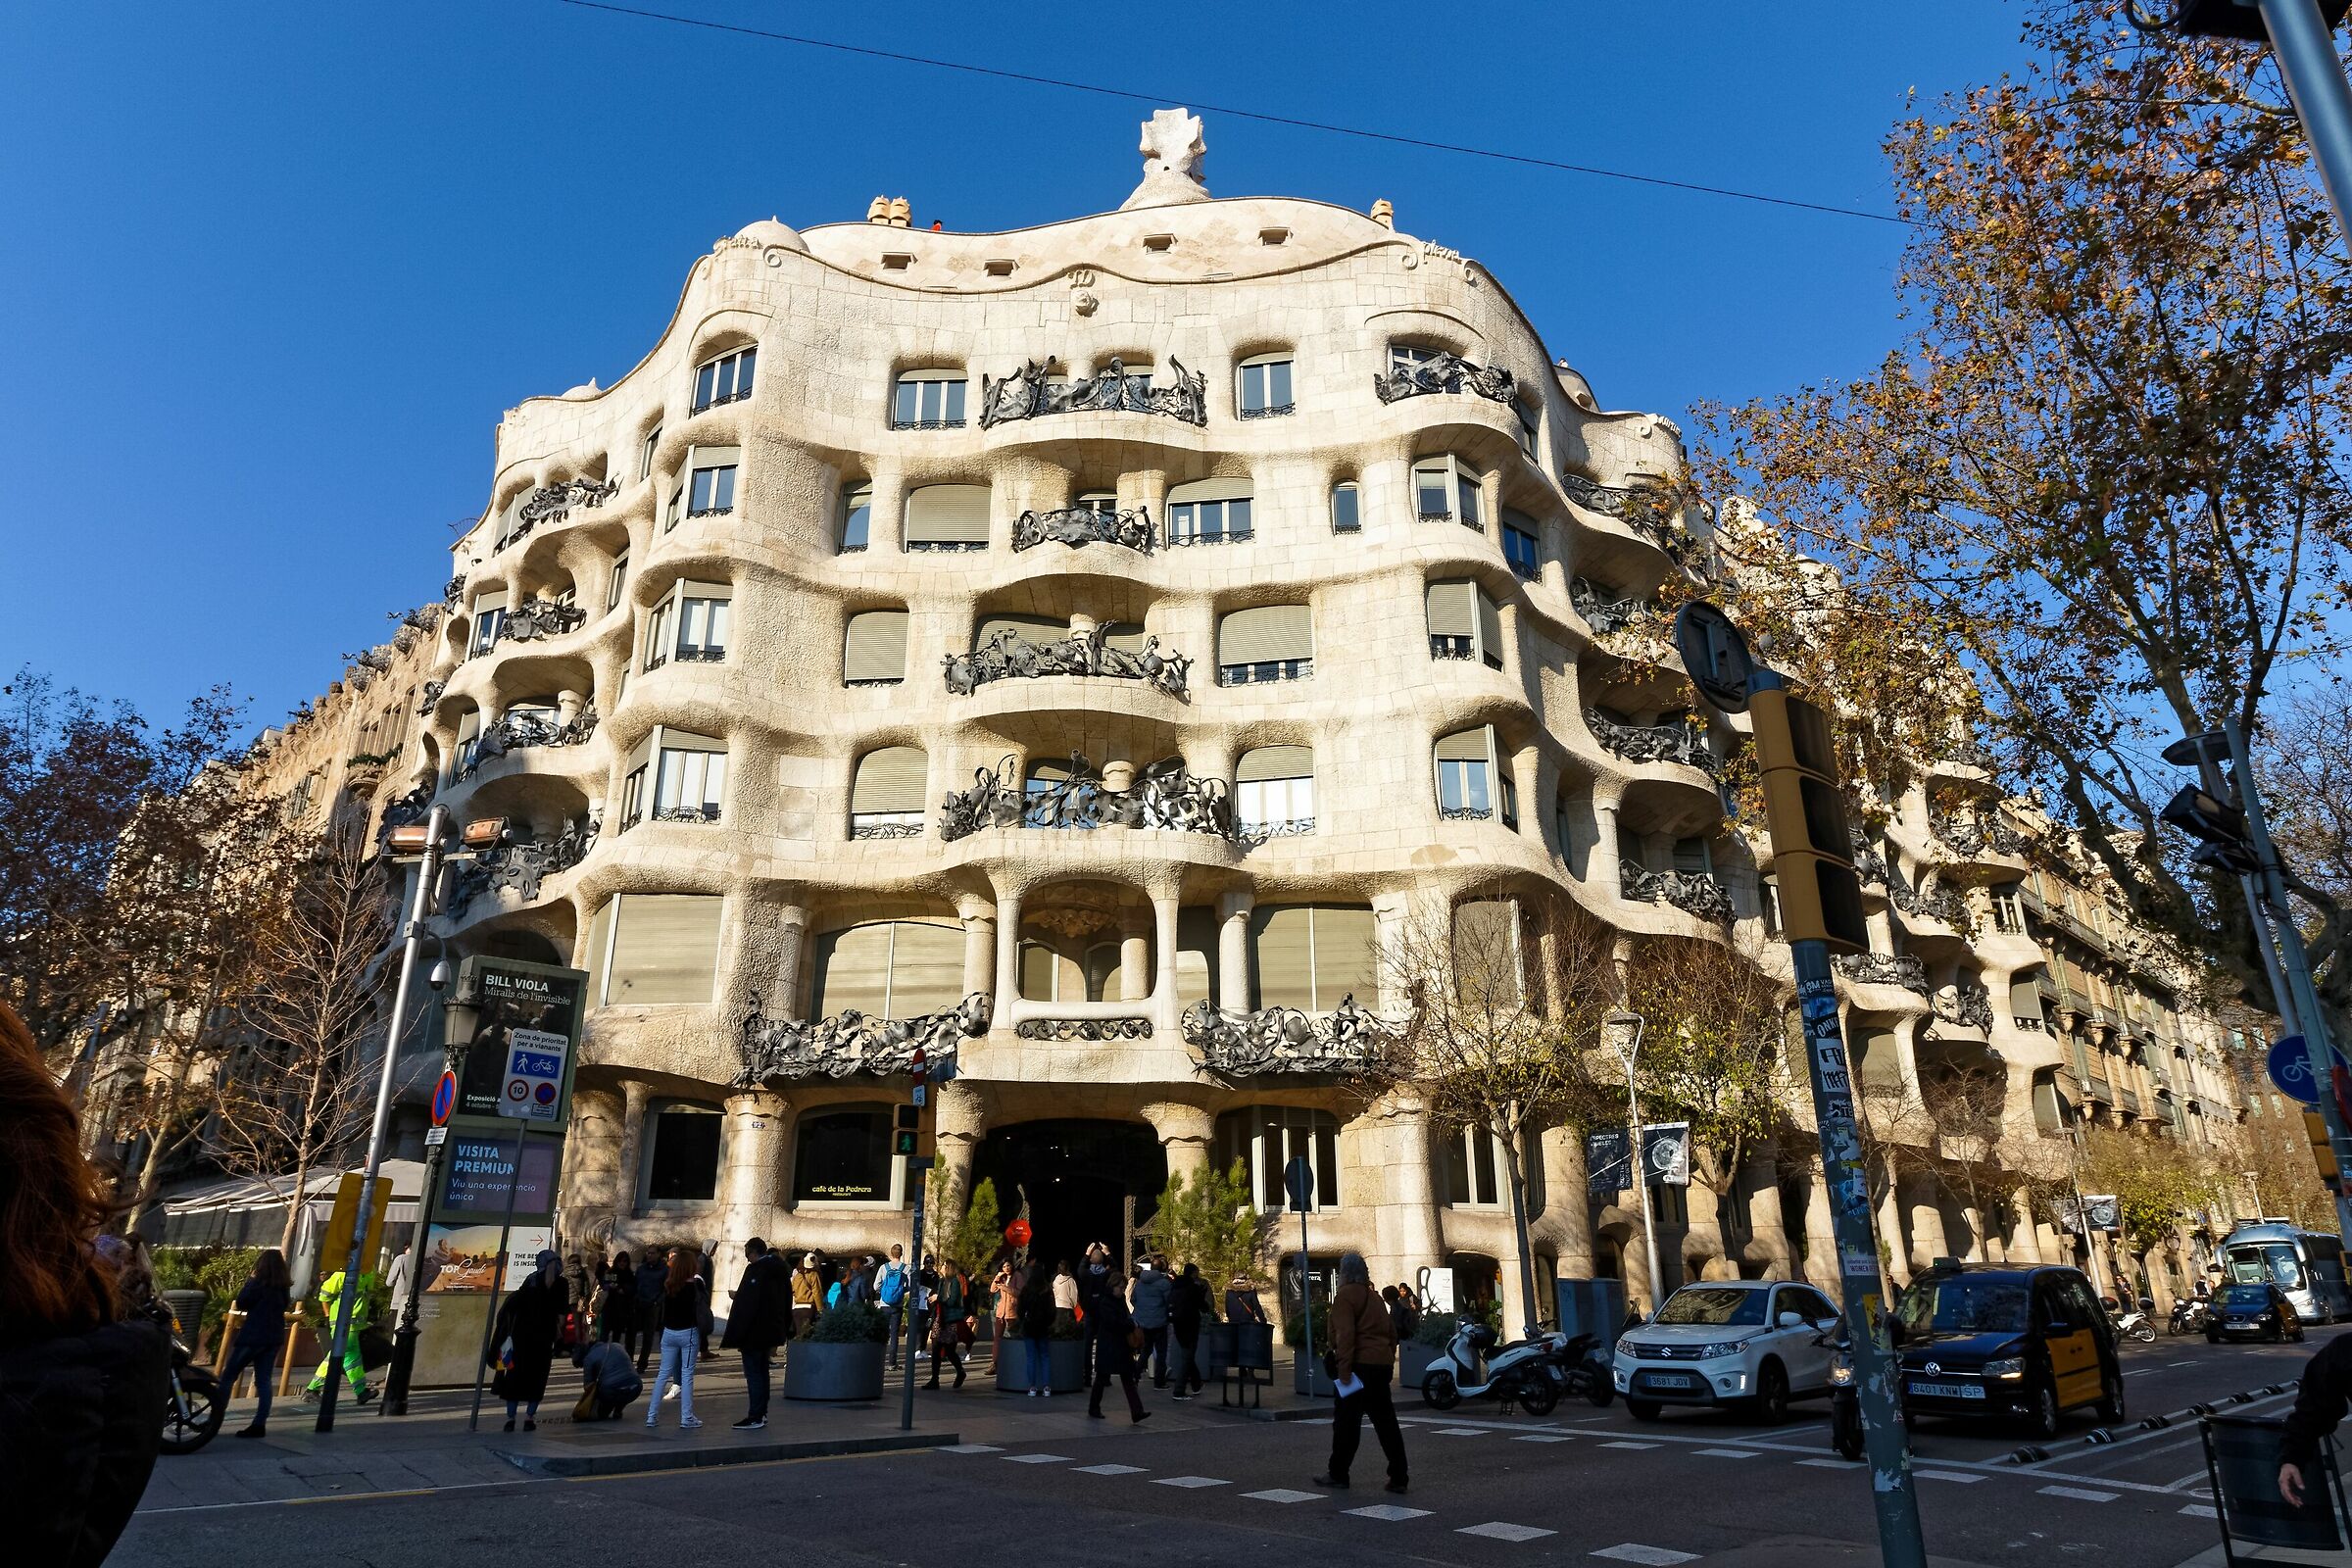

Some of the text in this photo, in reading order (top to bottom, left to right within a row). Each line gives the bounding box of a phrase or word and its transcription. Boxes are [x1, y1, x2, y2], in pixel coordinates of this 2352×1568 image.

[485, 974, 549, 992] BILL VIOLA
[484, 986, 571, 1005] Miralls de l'invisible
[541, 1037, 566, 1046] prioritat
[514, 1086, 523, 1095] 10
[466, 1094, 496, 1102] Exposició
[458, 1145, 499, 1158] VISITA
[452, 1177, 466, 1188] Viu
[487, 1183, 536, 1192] experncia
[449, 1192, 474, 1200] única
[1651, 1377, 1671, 1386] 3681
[1913, 1384, 1936, 1394] 6401
[1964, 1387, 1982, 1396] SP
